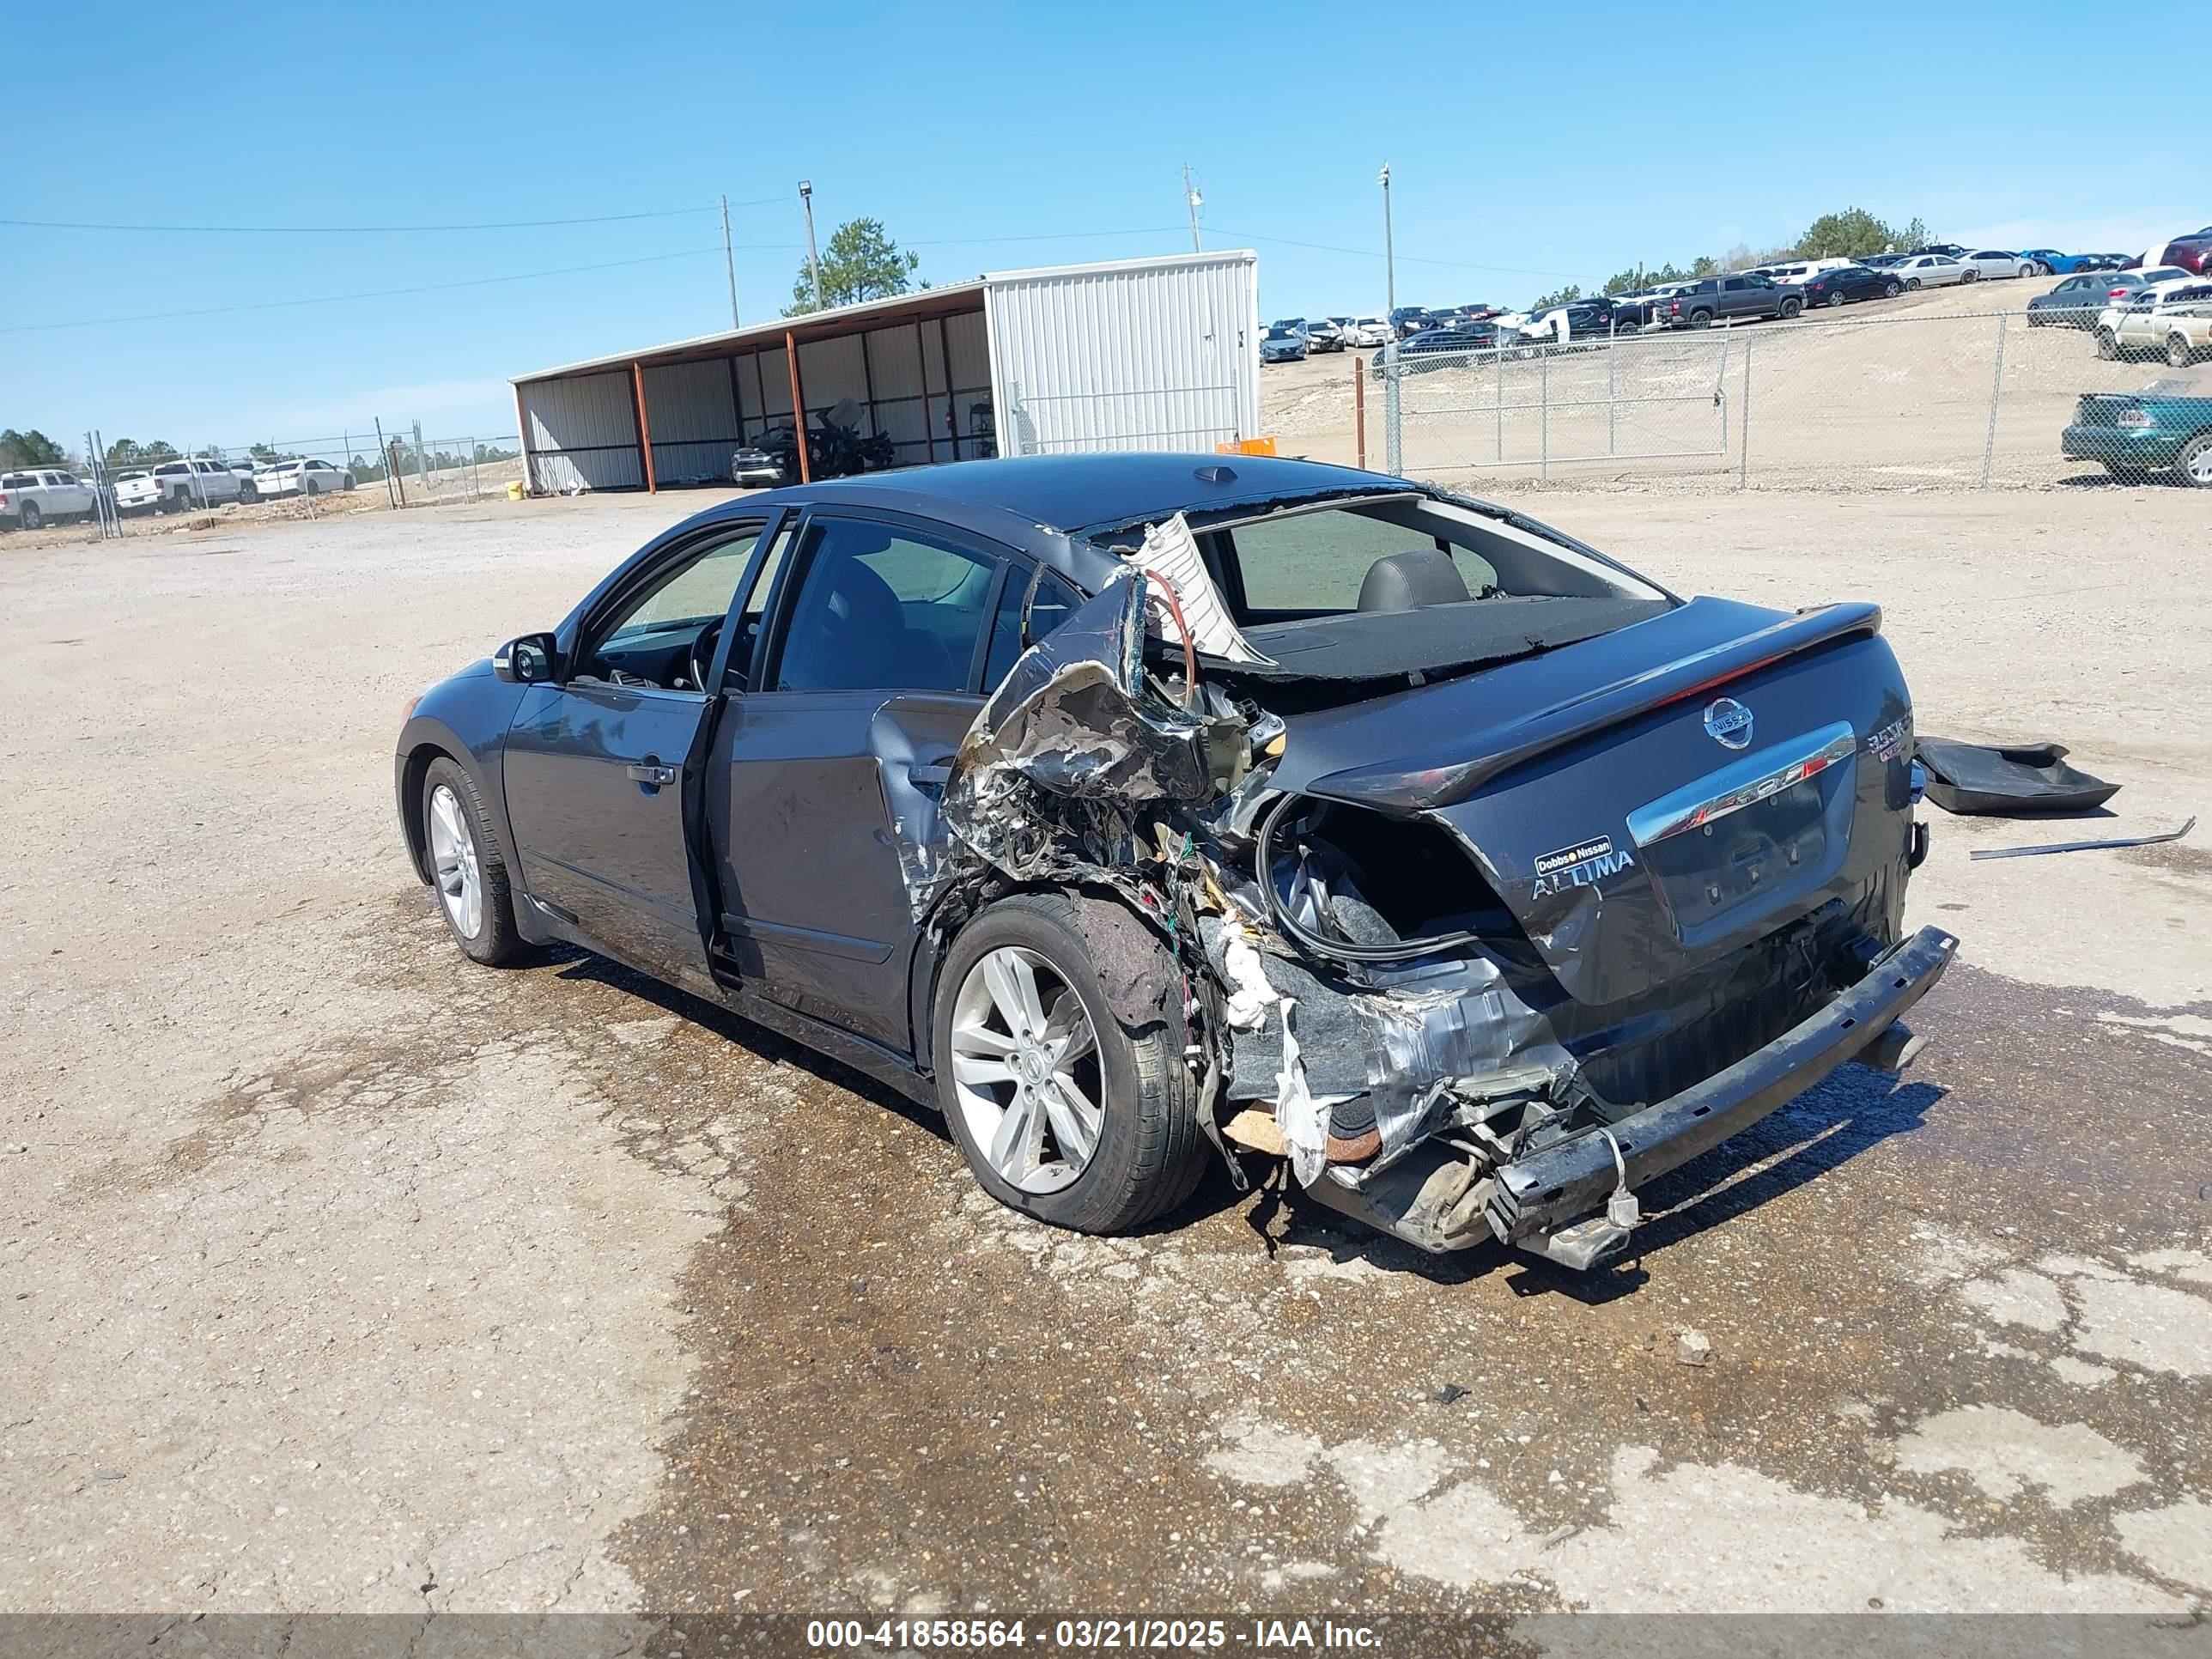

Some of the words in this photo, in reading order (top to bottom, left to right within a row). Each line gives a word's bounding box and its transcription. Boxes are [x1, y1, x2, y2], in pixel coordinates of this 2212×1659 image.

[1712, 710, 1751, 732] NISSAN
[1538, 854, 1570, 872] Dobbs
[1576, 842, 1610, 860] Nissan
[1532, 850, 1635, 901] ALTIMA
